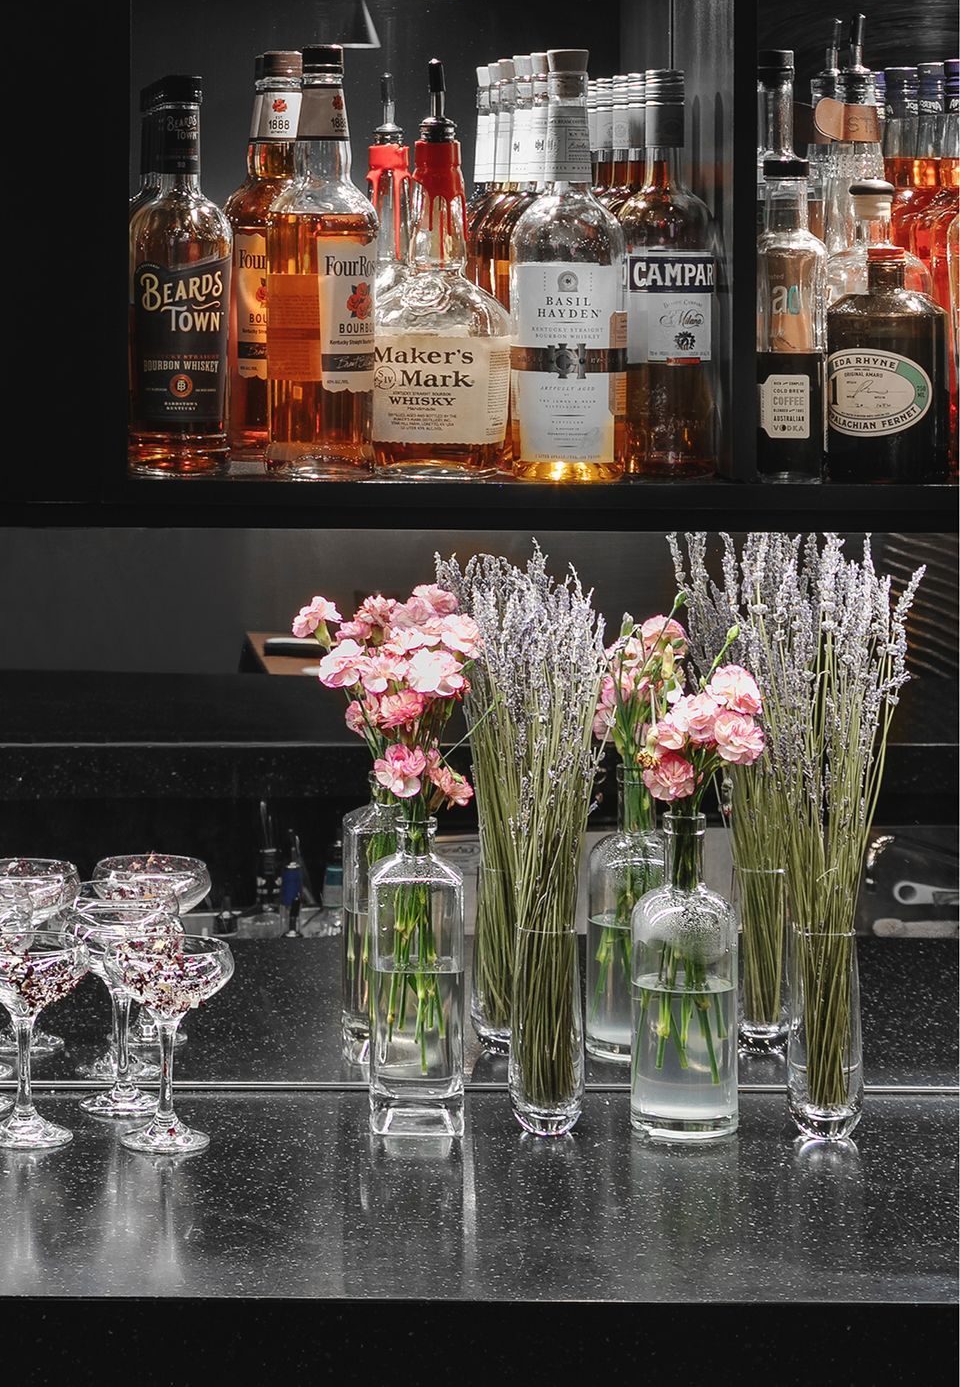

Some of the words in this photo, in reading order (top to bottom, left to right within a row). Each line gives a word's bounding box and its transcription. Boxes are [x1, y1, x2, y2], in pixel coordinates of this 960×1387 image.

[268, 119, 290, 130] 1888
[325, 255, 359, 277] Four
[140, 271, 223, 311] BEARDS
[545, 296, 592, 307] BASIL
[160, 305, 220, 332] TOWN
[537, 308, 600, 319] HAYDEN
[373, 346, 474, 364] Maker's
[143, 360, 180, 373] BOURBON
[183, 360, 219, 373] WHISKEY
[834, 357, 852, 368] EDA
[855, 356, 897, 369] RHYNE
[399, 369, 470, 388] Mark
[388, 396, 457, 406] WHISKY
[773, 396, 805, 406] COFFEE
[881, 406, 918, 428] FERNET
